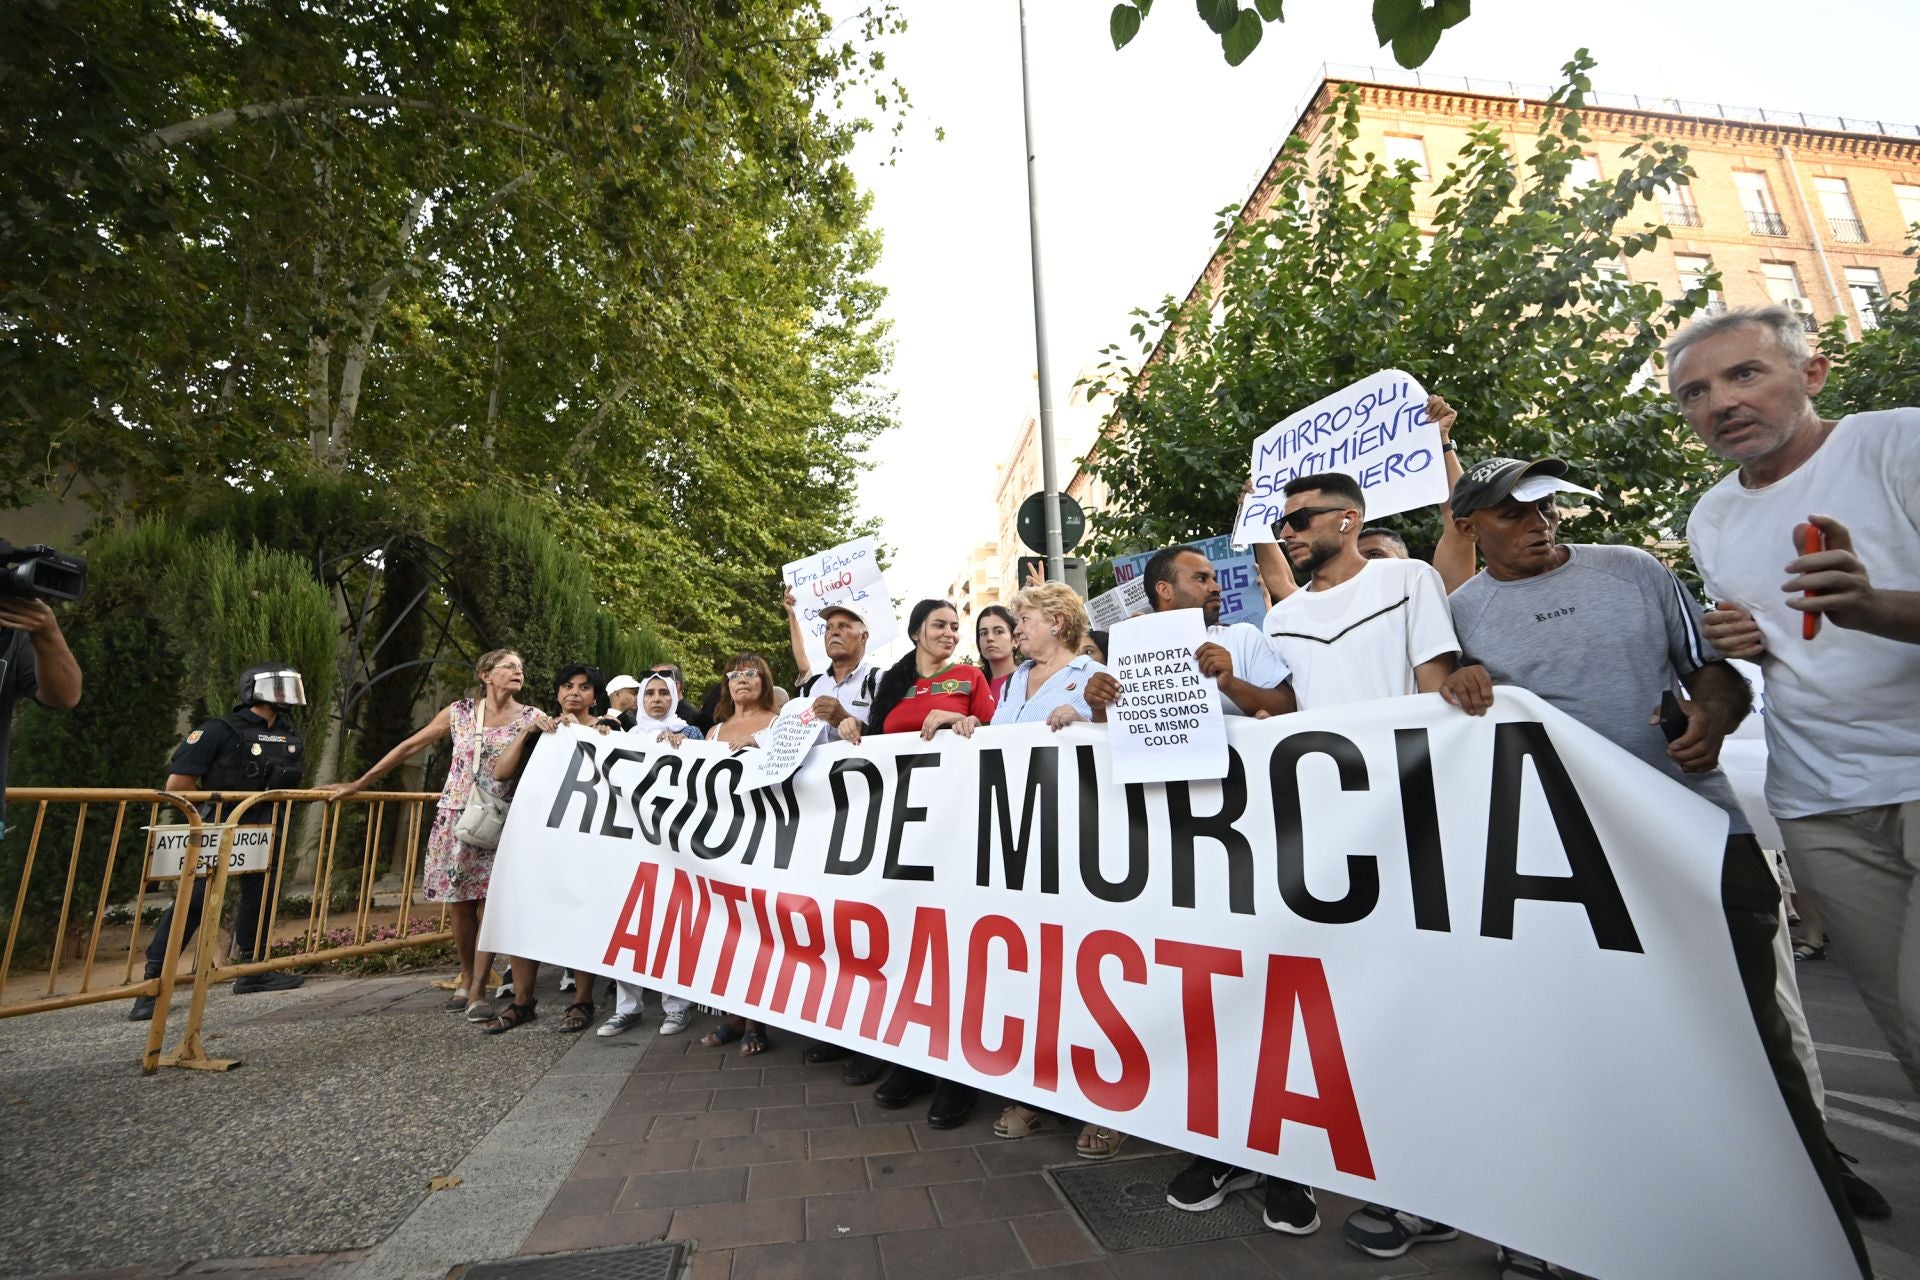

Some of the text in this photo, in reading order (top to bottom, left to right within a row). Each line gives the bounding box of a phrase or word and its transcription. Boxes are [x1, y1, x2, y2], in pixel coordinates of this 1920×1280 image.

[788, 550, 866, 588] Torre Pacheco
[1118, 647, 1192, 667] NO IMPORTA
[1119, 662, 1192, 680] DE LA RAZA
[1119, 675, 1200, 694] QUE ERES. EN
[1115, 689, 1207, 708] LA OSCURIDAD
[1117, 703, 1209, 721] TODOS SOMOS
[1129, 718, 1199, 735] DEL MISMO
[1144, 734, 1189, 747] COLOR
[200, 834, 219, 848] DE
[232, 832, 269, 846] URCIA
[546, 721, 1645, 955] REGIÓN DE MURCIA
[178, 853, 245, 871] FSTEOS
[602, 861, 1376, 1181] ANTIRRACISTA
